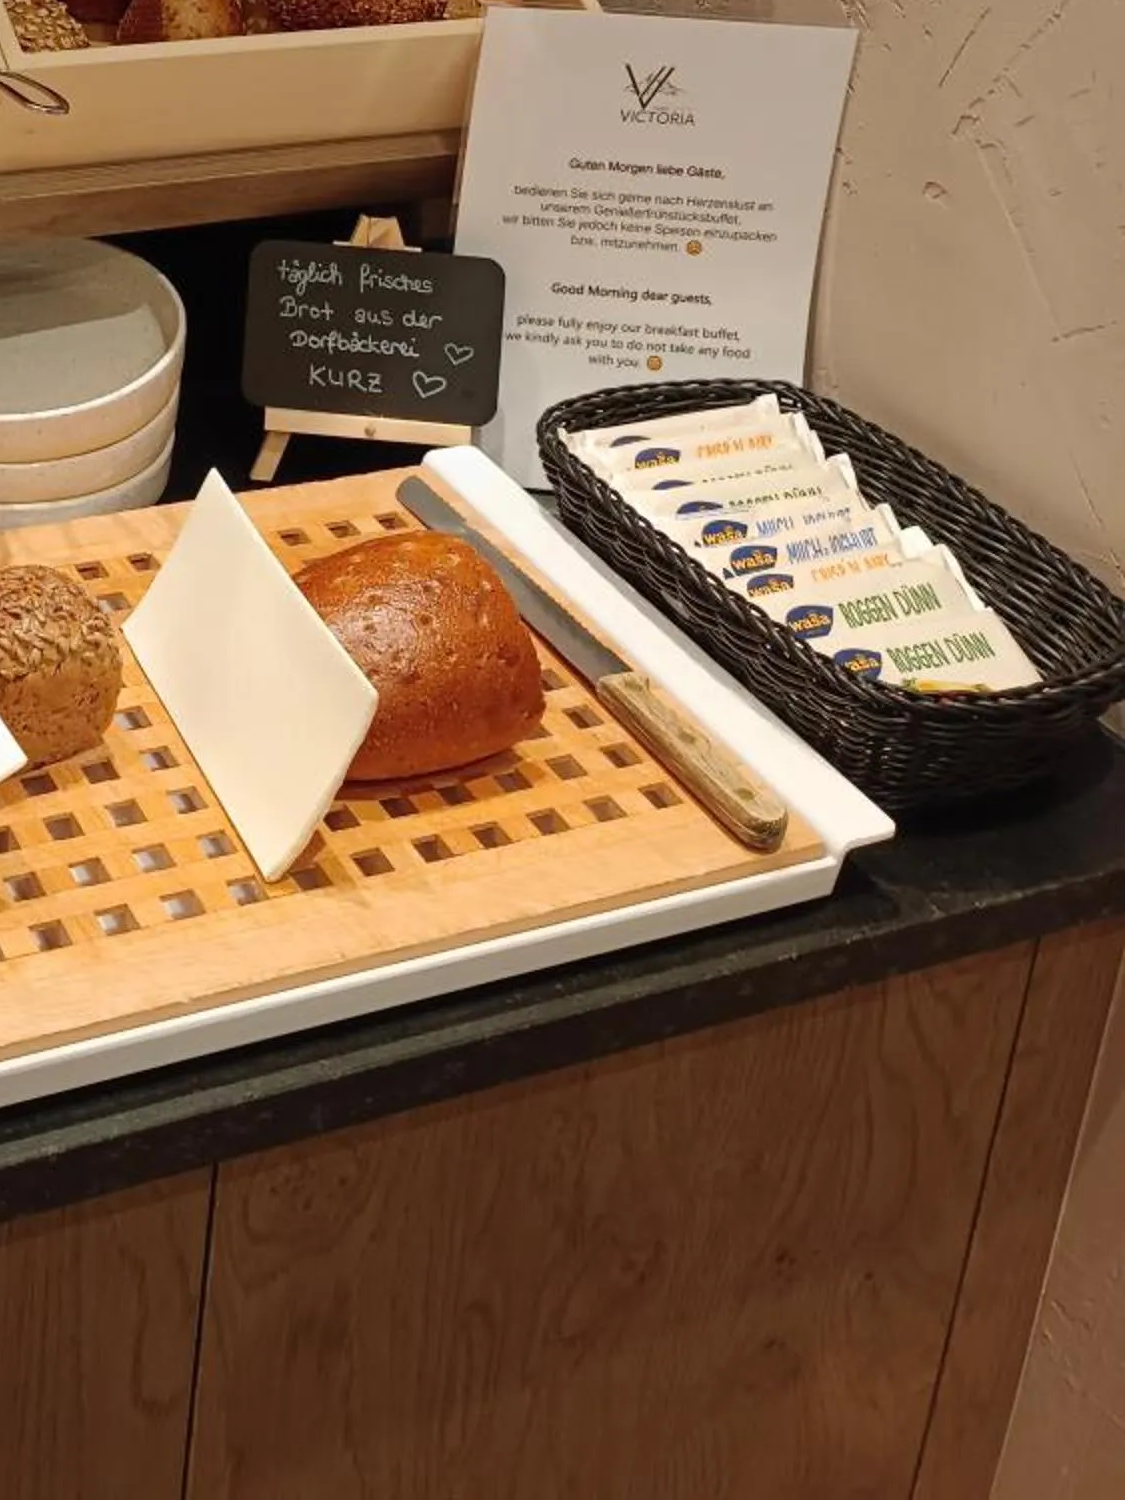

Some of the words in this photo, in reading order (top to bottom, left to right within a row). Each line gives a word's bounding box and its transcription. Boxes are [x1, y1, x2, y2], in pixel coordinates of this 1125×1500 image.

[620, 109, 695, 126] VICTORIA
[569, 158, 605, 171] Guten
[608, 161, 653, 175] Morgen
[656, 164, 683, 176] liebe
[570, 187, 588, 199] Sie
[592, 189, 615, 201] sich
[618, 193, 651, 205] gerne
[655, 195, 683, 206] nach
[522, 215, 554, 227] bitten
[557, 217, 576, 229] Sie
[578, 220, 617, 232] jedoch
[620, 222, 651, 233] keine
[654, 223, 701, 238] Speisen
[276, 259, 343, 295] täglich
[360, 263, 434, 294] frisches
[551, 281, 584, 296] Good
[588, 284, 638, 302] Morning
[641, 289, 668, 302] dear
[279, 295, 335, 322] Brot
[354, 308, 394, 326] aus
[402, 309, 443, 329] der
[516, 314, 554, 328] please
[558, 316, 583, 330] fully
[586, 320, 618, 334] enjoy
[621, 323, 641, 333] our
[644, 324, 699, 338] breakfast
[288, 329, 420, 358] Dorfbäckerei
[505, 332, 522, 341] we
[525, 332, 559, 346] kindly
[563, 336, 582, 346] ask
[586, 339, 608, 350] you
[611, 339, 623, 350] to
[626, 340, 643, 351] do
[646, 342, 667, 353] not
[670, 343, 695, 355] take
[698, 346, 720, 359] any
[722, 346, 751, 360] food
[588, 354, 614, 366] with
[308, 363, 383, 394] KURZ
[838, 592, 899, 629] ROGGEN
[892, 578, 942, 617] DÜNN
[886, 639, 950, 674] ROGGEN
[944, 629, 996, 664] DÜNN
